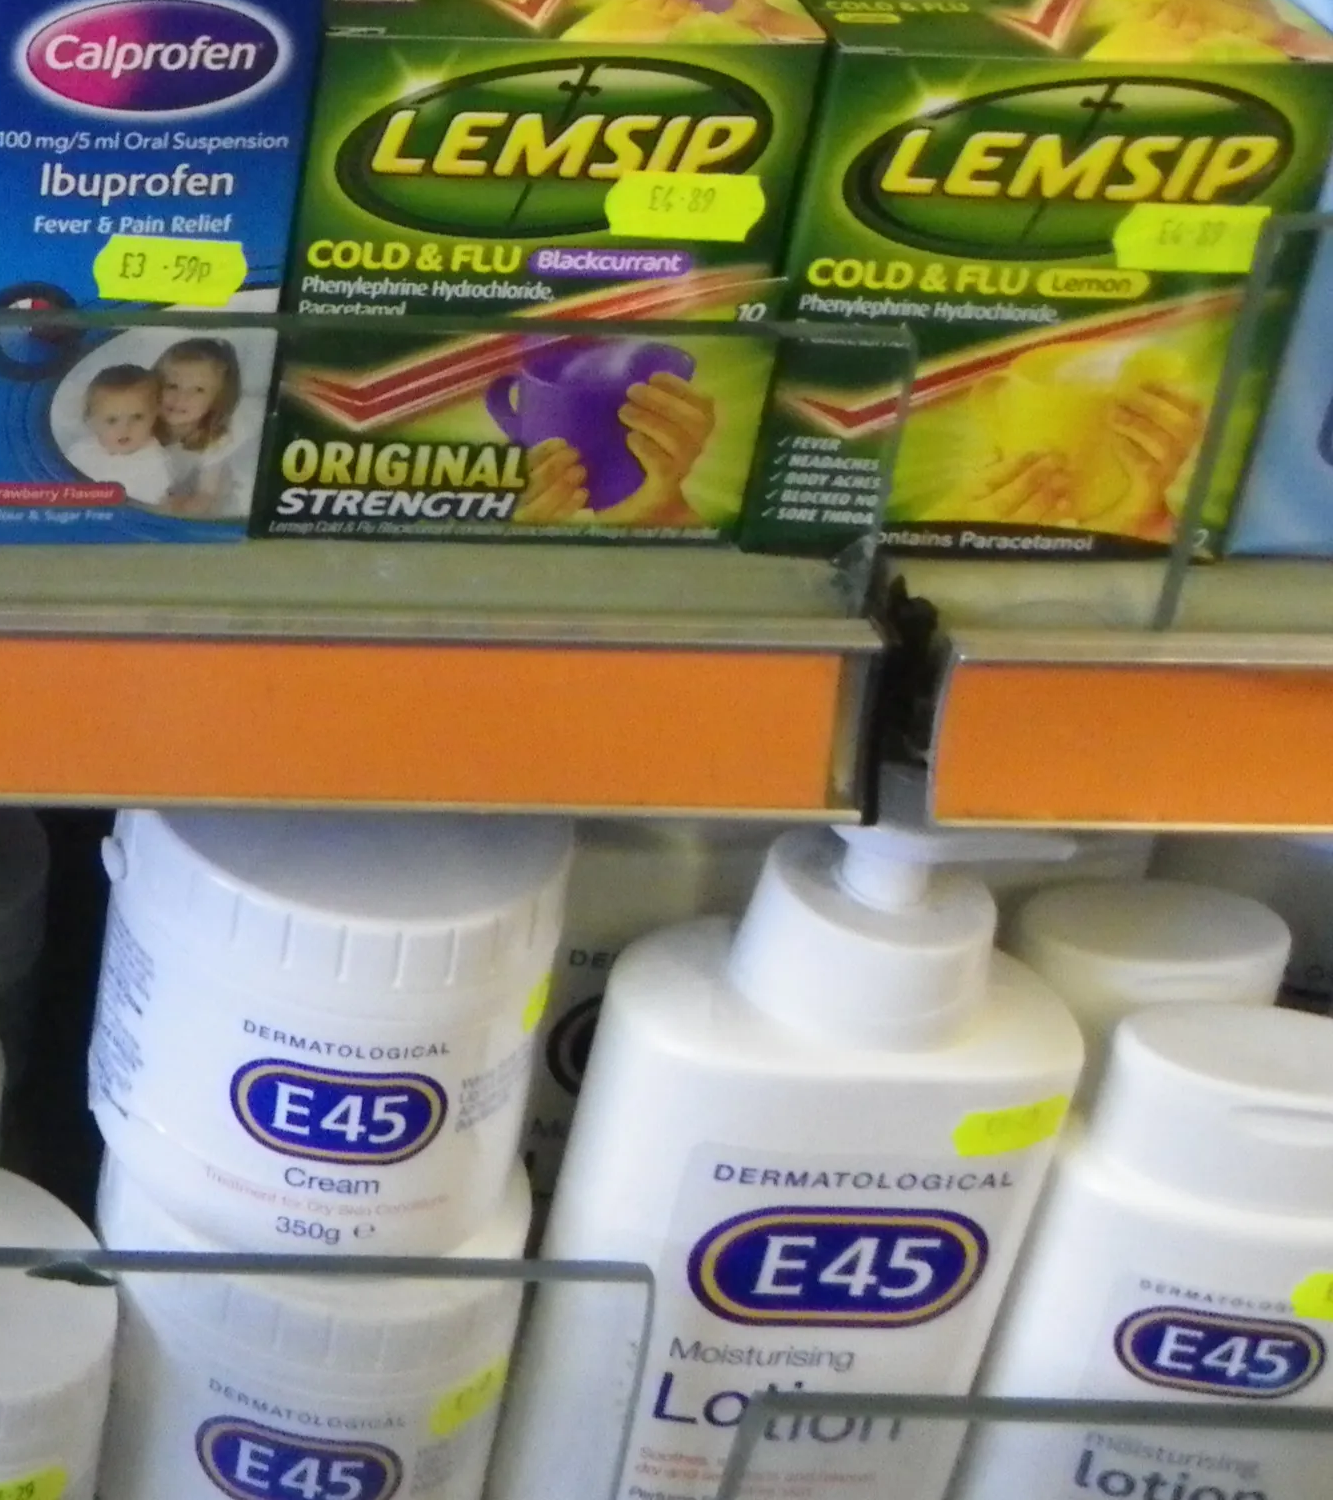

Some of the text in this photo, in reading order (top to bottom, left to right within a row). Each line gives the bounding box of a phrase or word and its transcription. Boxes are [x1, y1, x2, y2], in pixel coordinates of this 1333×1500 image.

[44, 34, 257, 79] Calprofen
[35, 132, 91, 154] mg/5
[94, 131, 120, 149] ml
[124, 132, 169, 150] Oral
[173, 133, 290, 156] Suspension
[370, 108, 759, 180] LEMSIP
[881, 128, 1282, 202] LEMSIP
[39, 163, 235, 207] Ibuprofen
[33, 214, 233, 235] Fever & Pain Relief
[307, 238, 685, 274] COLD & FLU Blackcurrant
[301, 277, 555, 303] Phenylephrine Hydrochloride,
[807, 257, 1132, 296] COLD & FLU Lemon
[798, 293, 932, 319] Phenylephrine
[280, 439, 528, 489] ORIGINAL
[63, 486, 115, 501] Flavour
[276, 490, 515, 519] STRENGTH
[243, 1019, 451, 1059] DERMATOLOGICAL
[272, 1081, 410, 1144] E45
[283, 1167, 381, 1196] Cream
[714, 1163, 1016, 1192] DERMATOLOGICAL
[274, 1215, 341, 1245] 350g
[750, 1235, 942, 1298] E45
[668, 1336, 856, 1371] Moisturising
[1154, 1324, 1296, 1383] E45
[208, 1379, 409, 1429] DERMATOLOGICAL
[233, 1440, 366, 1500] E45
